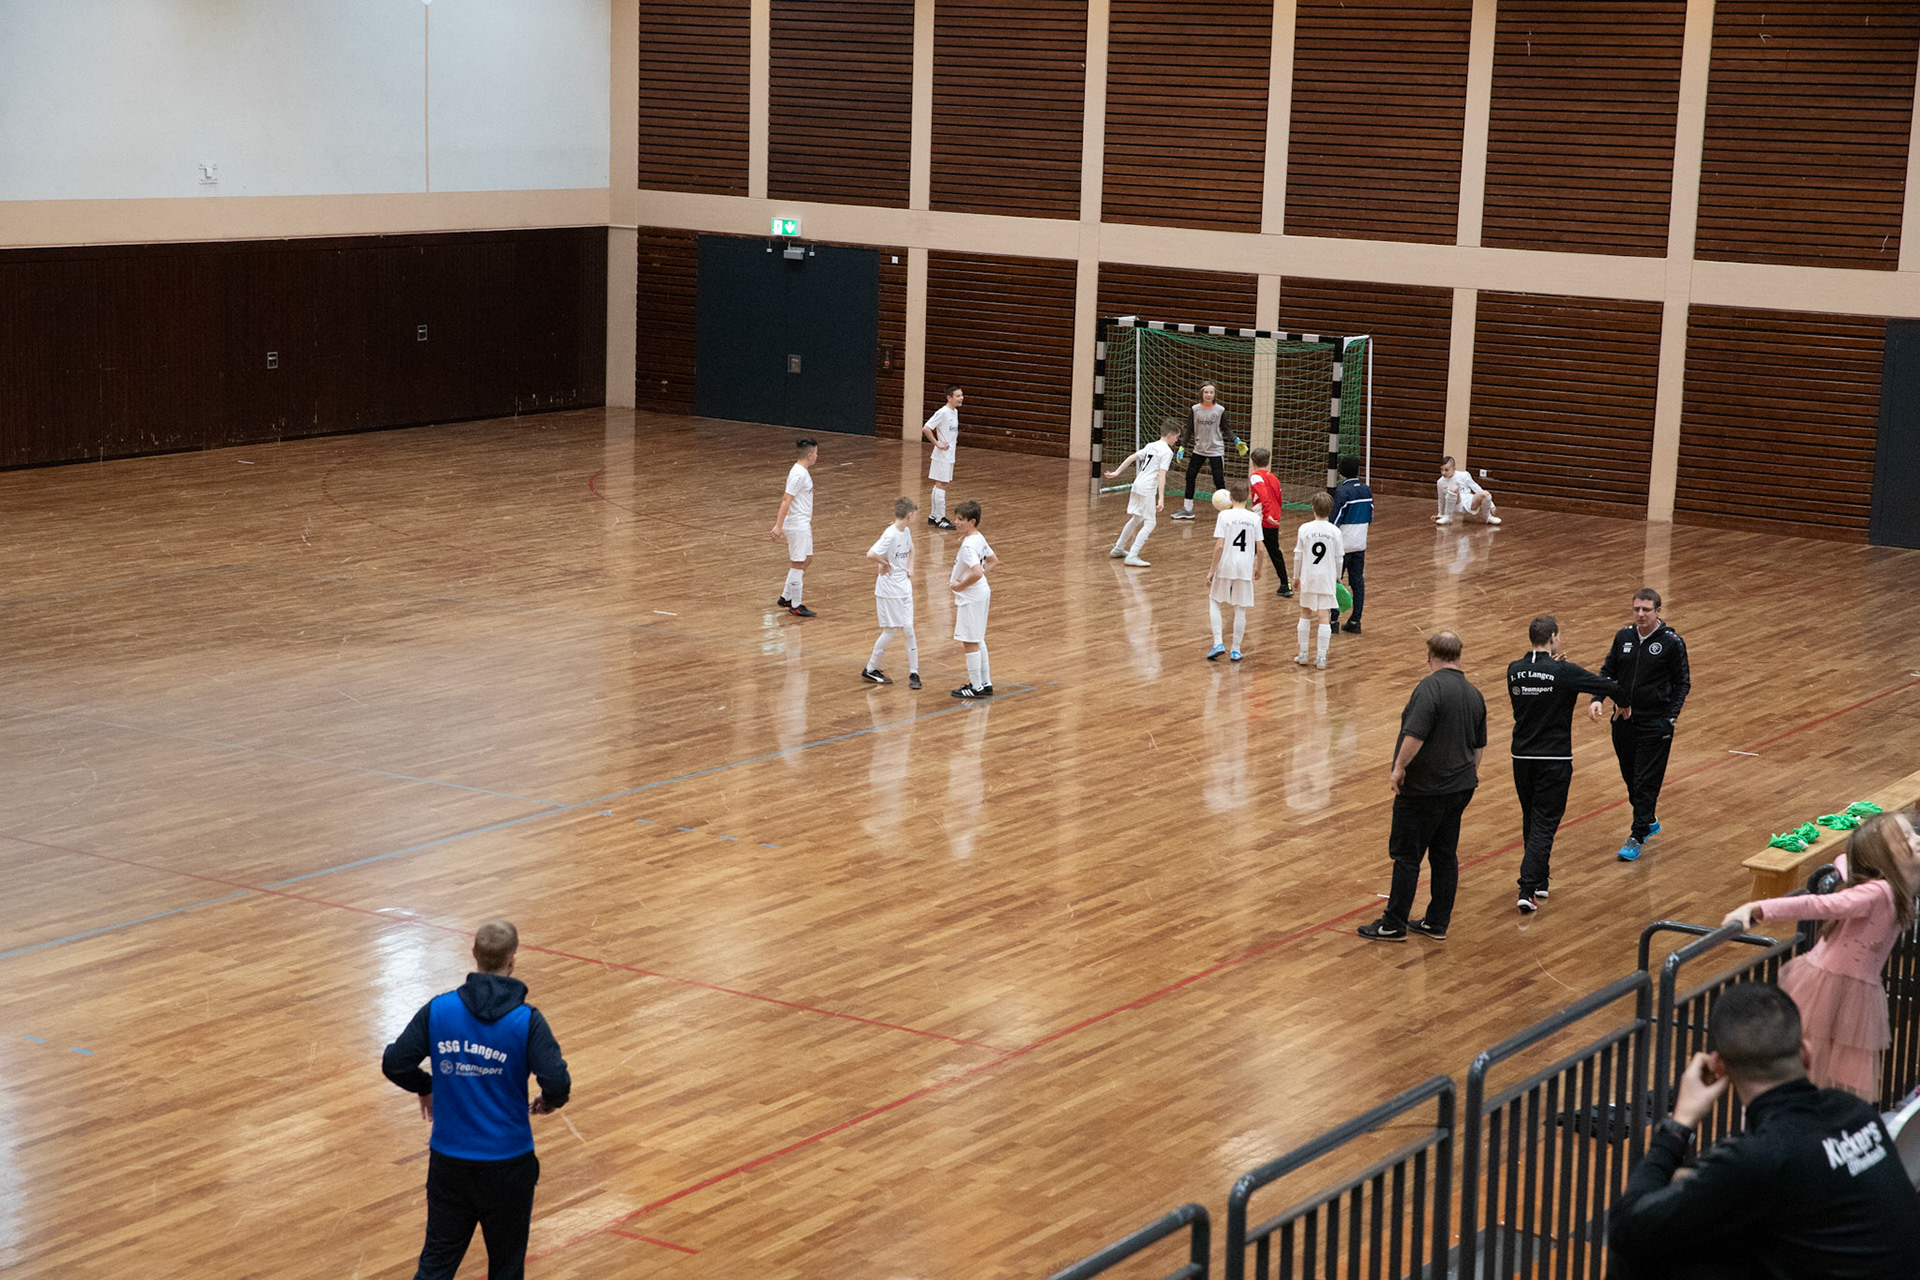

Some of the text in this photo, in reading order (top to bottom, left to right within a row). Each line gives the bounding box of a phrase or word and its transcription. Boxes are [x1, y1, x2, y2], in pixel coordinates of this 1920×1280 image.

[1232, 529, 1247, 552] 4
[1311, 541, 1327, 565] 9
[1517, 670, 1527, 679] FC
[1528, 670, 1555, 681] Langen
[437, 1039, 508, 1063] SSG Langen
[455, 1061, 504, 1075] Teamsport
[1821, 1120, 1883, 1170] Kickers
